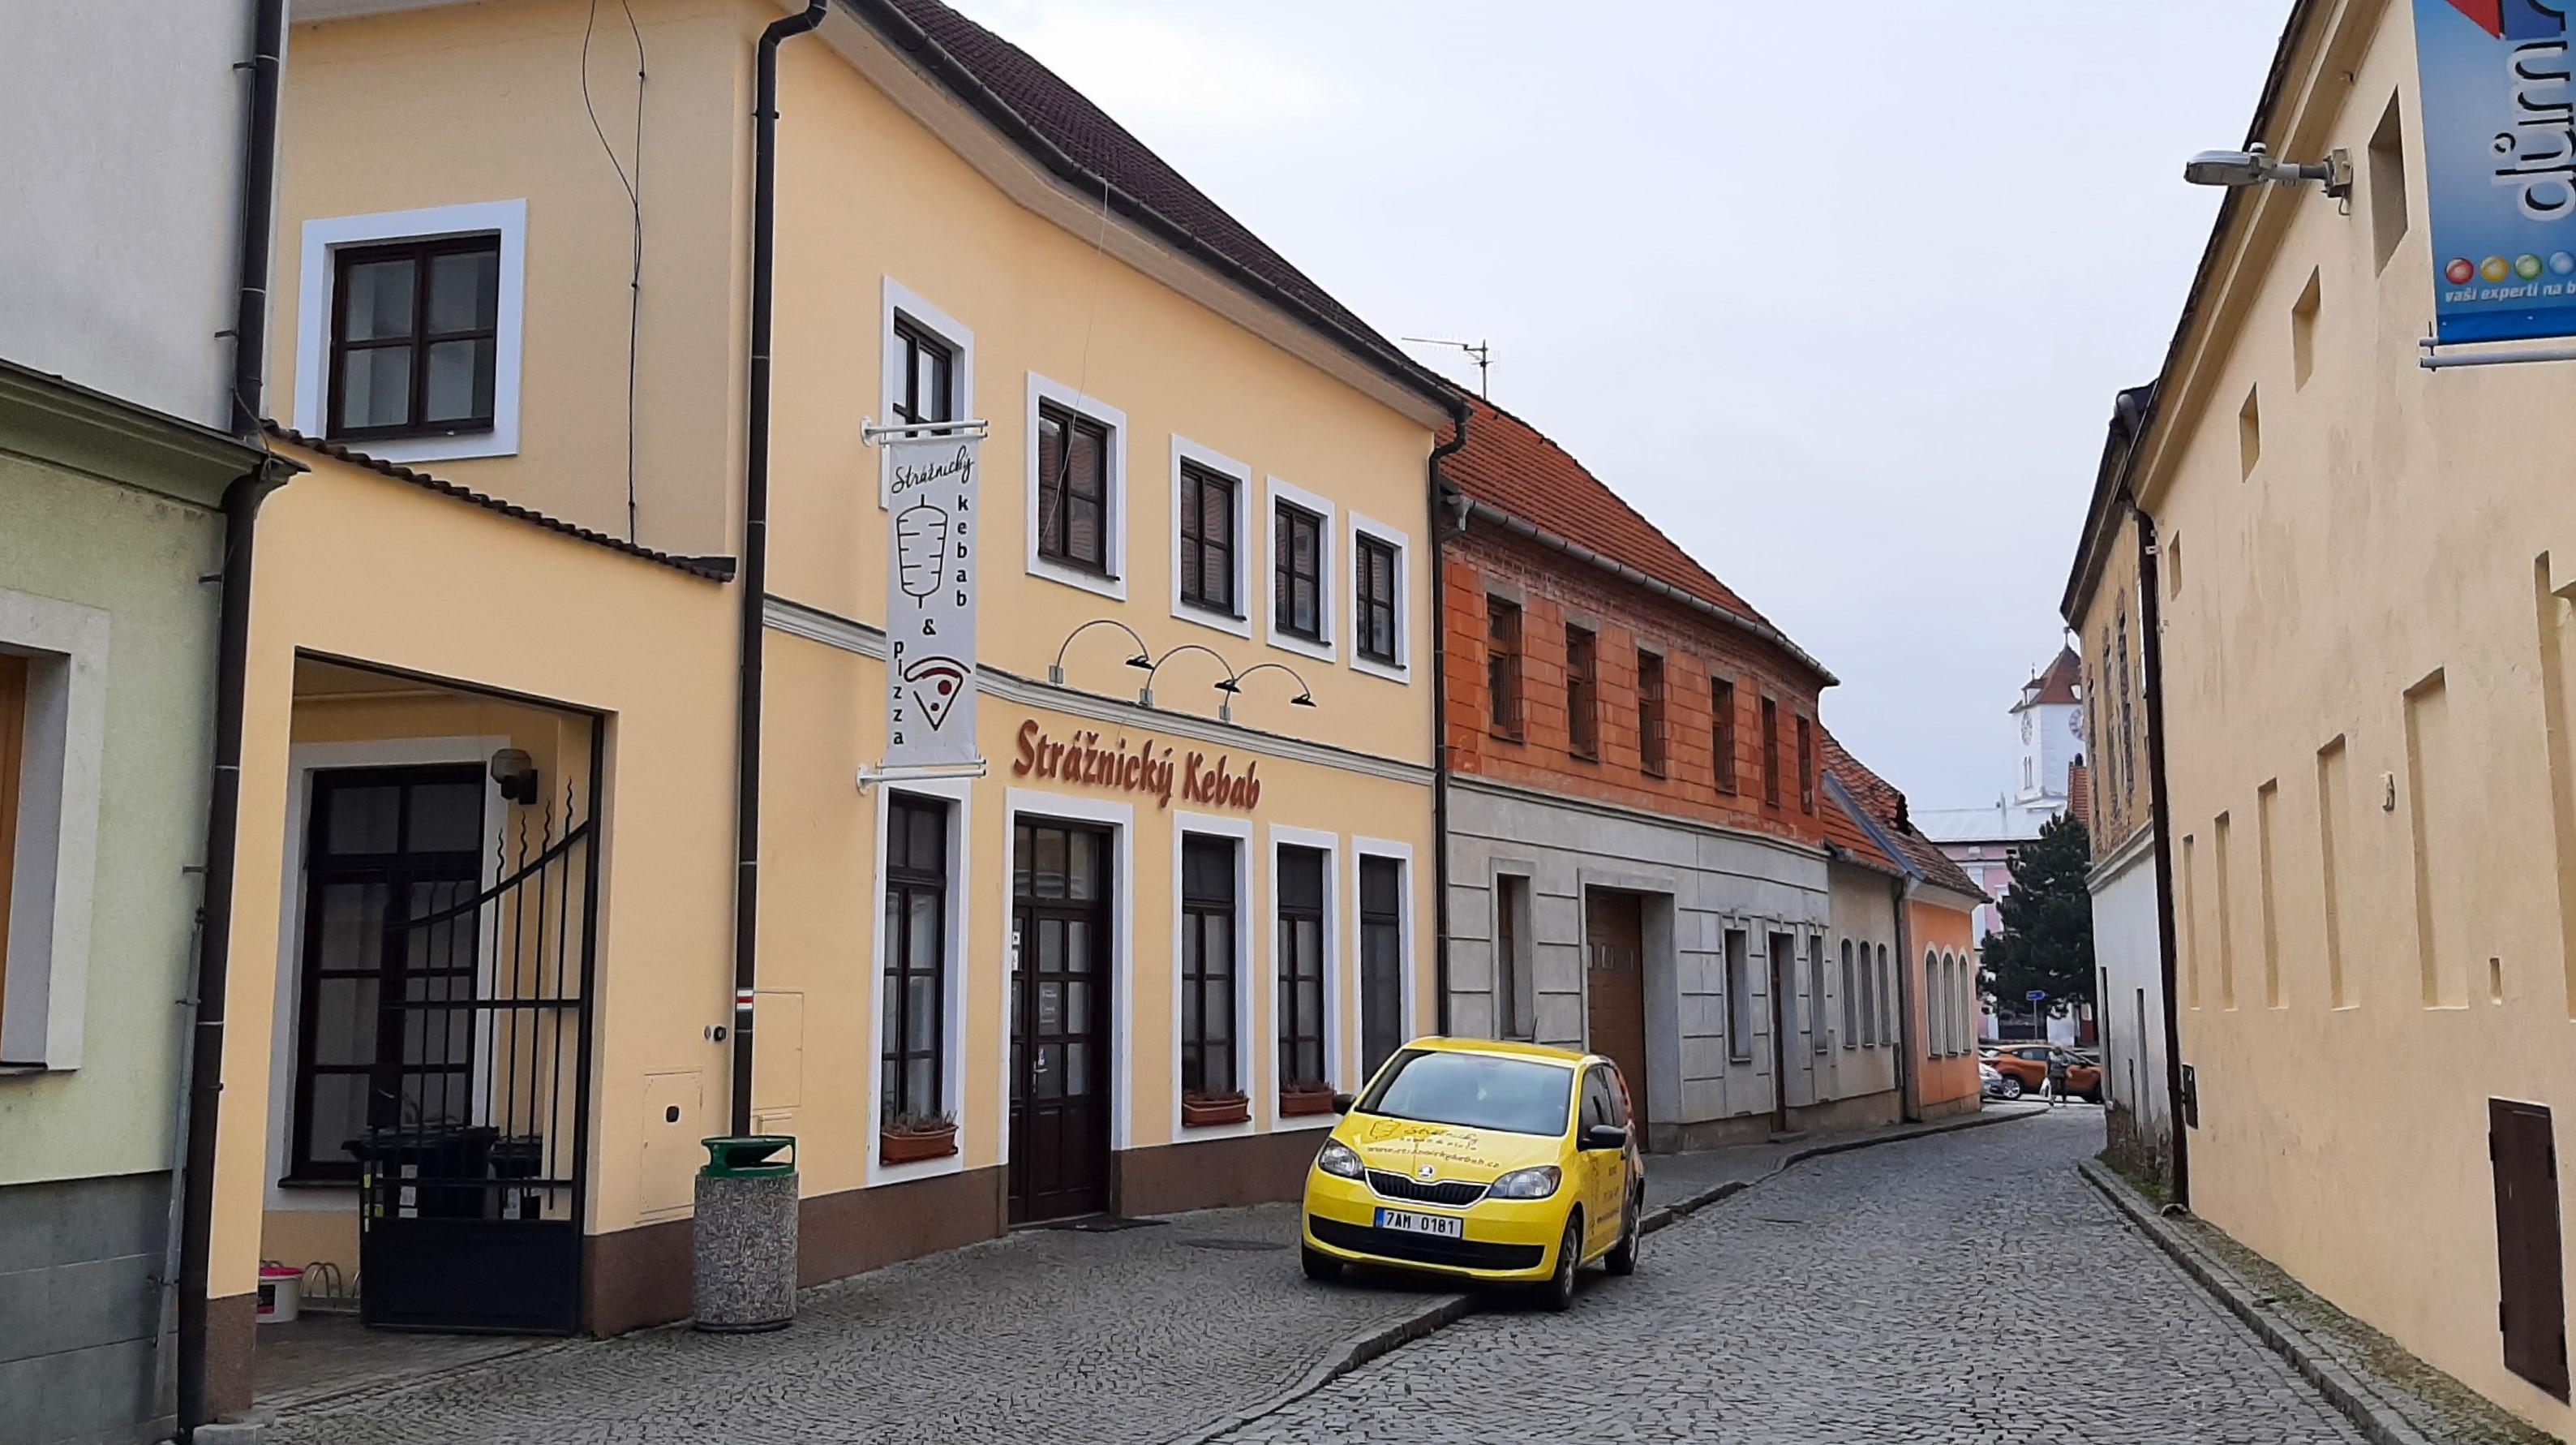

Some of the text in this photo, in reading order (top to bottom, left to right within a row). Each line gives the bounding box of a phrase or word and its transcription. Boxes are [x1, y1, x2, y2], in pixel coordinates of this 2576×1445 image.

[2445, 287, 2477, 303] vaši
[2481, 282, 2539, 302] experti
[2543, 283, 2563, 296] na
[891, 445, 975, 493] Strážnický
[955, 494, 968, 607] kebab
[922, 618, 937, 636] &
[893, 640, 904, 745] pizza
[1013, 719, 1261, 810] Strážnický Kebab
[1386, 1211, 1454, 1234] 7AM 0181
